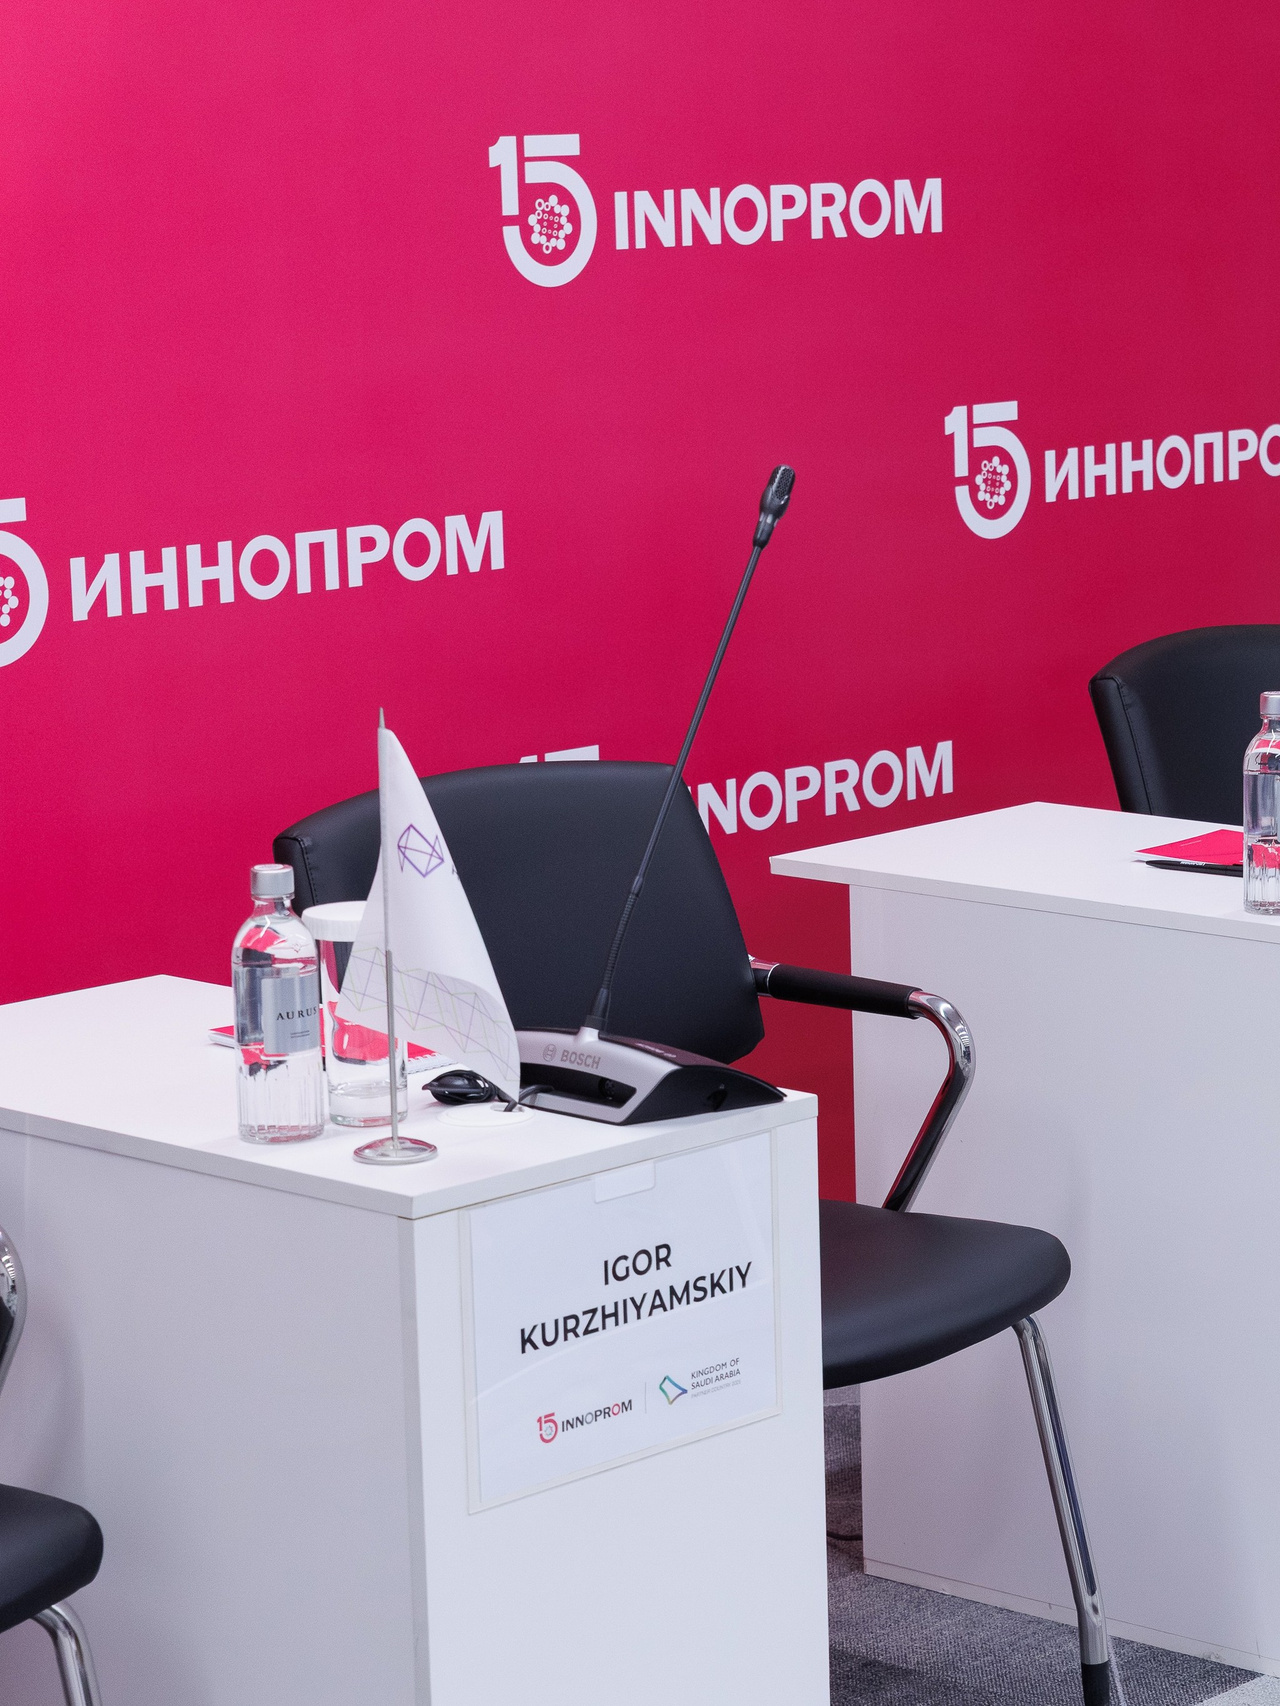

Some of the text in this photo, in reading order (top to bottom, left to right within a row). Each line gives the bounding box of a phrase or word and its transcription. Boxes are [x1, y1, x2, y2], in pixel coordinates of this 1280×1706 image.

[488, 133, 943, 288] 15 INNOPROM
[944, 401, 1032, 540] 15
[70, 510, 505, 622] ИННОПРОМ
[687, 740, 954, 836] NOPROM
[276, 1006, 318, 1021] AURUS
[560, 1049, 602, 1070] BOSCH
[603, 1243, 672, 1286] IGOR
[520, 1261, 752, 1354] KURZHIYAMSKIY
[691, 1357, 740, 1380] KINGDOM OF
[691, 1368, 741, 1390] SAUDI ARABIA
[537, 1398, 633, 1444] 15 INNOPROM
